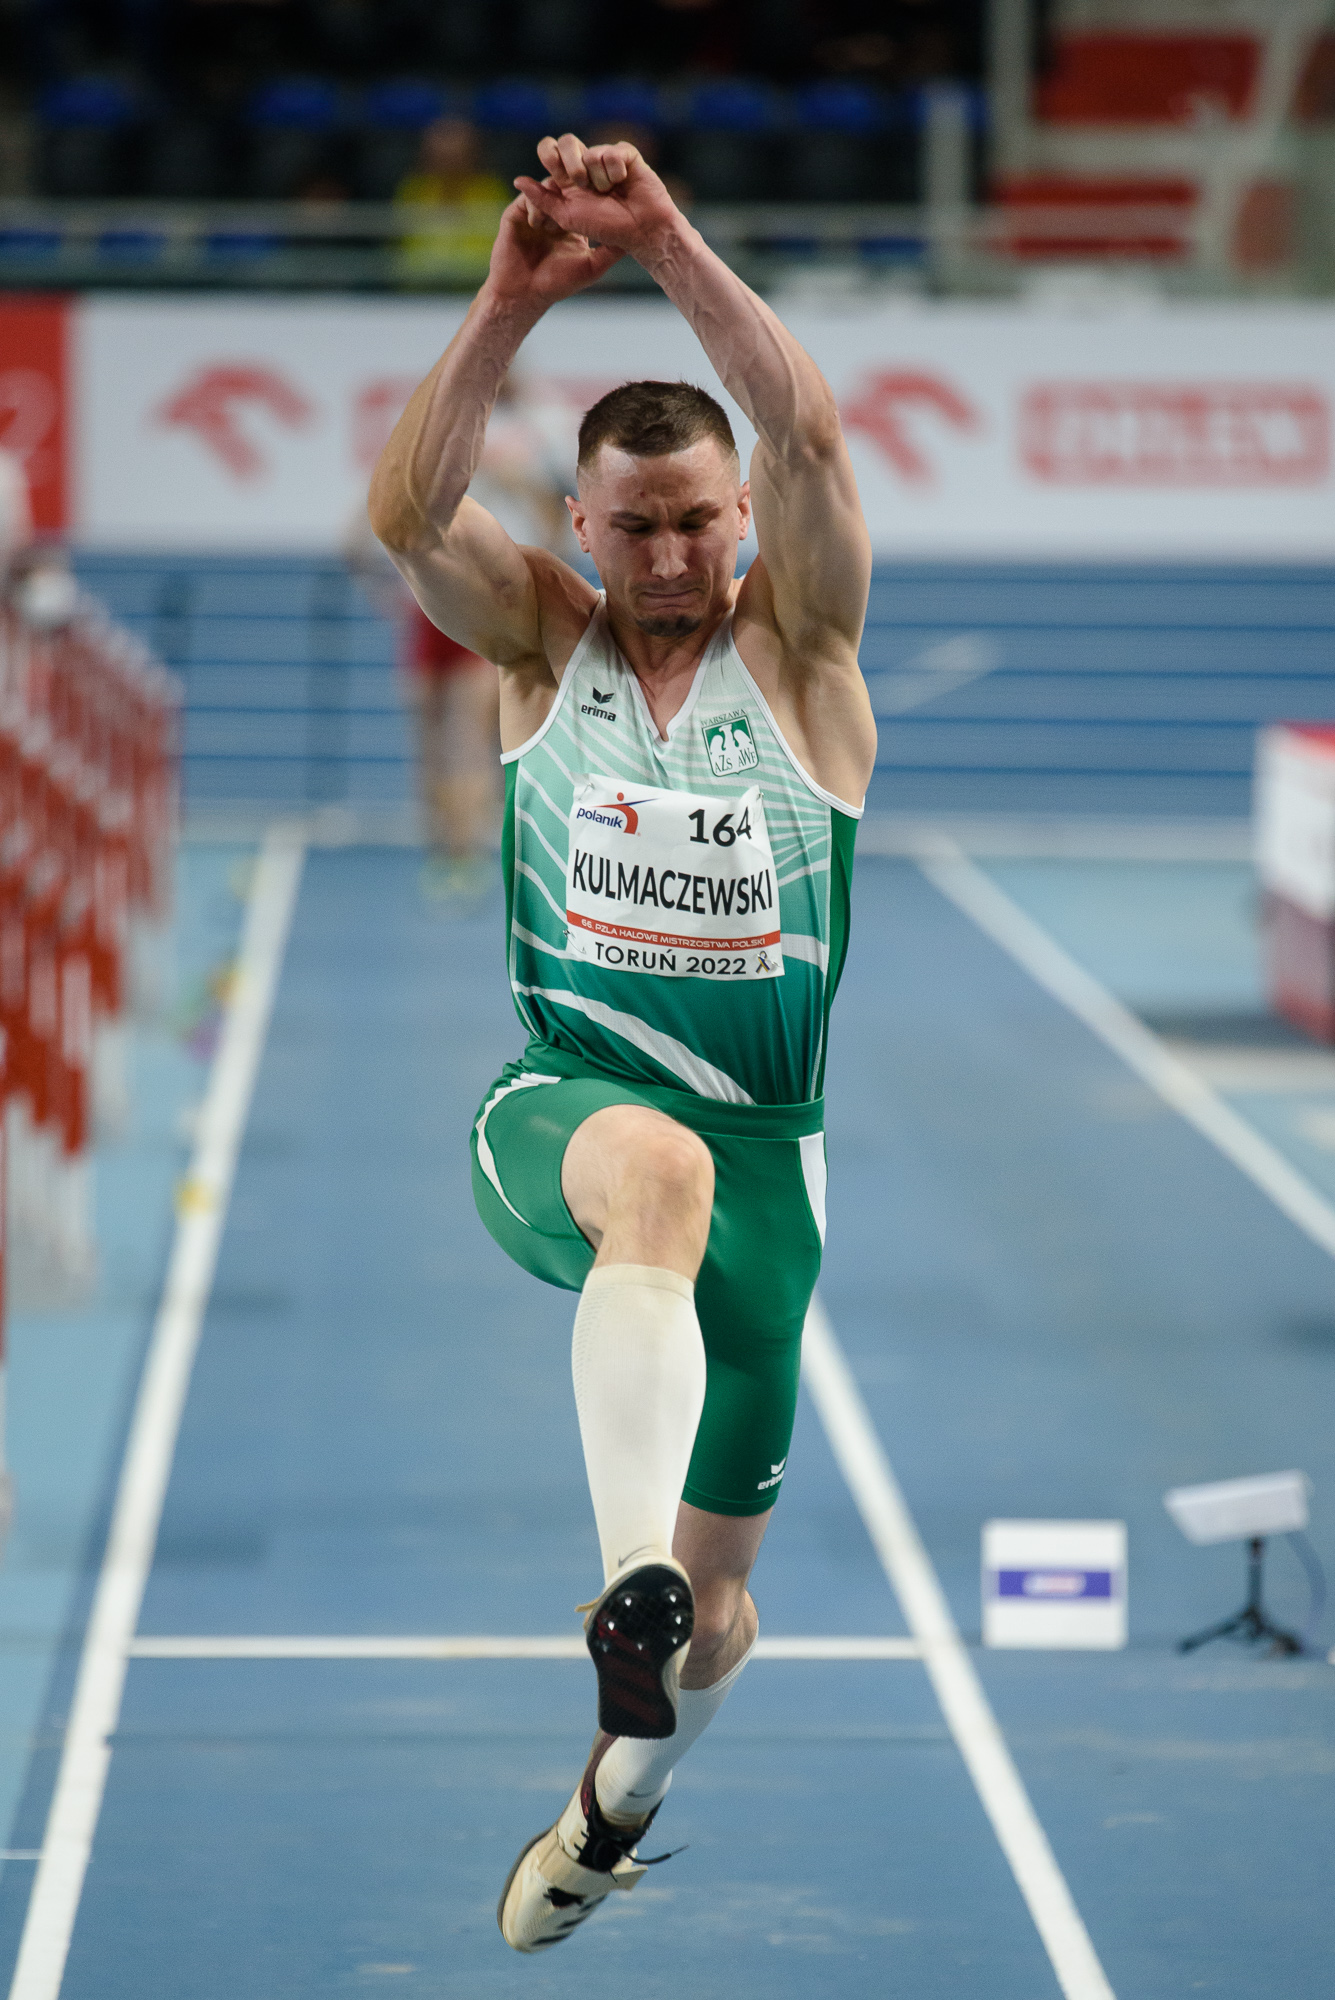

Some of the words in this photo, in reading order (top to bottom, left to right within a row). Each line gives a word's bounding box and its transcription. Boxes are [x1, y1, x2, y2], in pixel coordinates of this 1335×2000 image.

[581, 704, 617, 722] erima
[700, 708, 747, 726] WARSZAWA
[714, 754, 734, 774] AZS
[738, 747, 757, 768] AWF
[688, 806, 752, 848] 164
[572, 848, 773, 917] KULMACZEWSKI
[595, 923, 618, 936] PZLA
[619, 929, 658, 943] HALOWE
[660, 936, 731, 949] MISTRZOSTWA
[732, 937, 766, 949] POLSKI
[595, 941, 676, 972] TORUŃ
[686, 956, 746, 975] 2022
